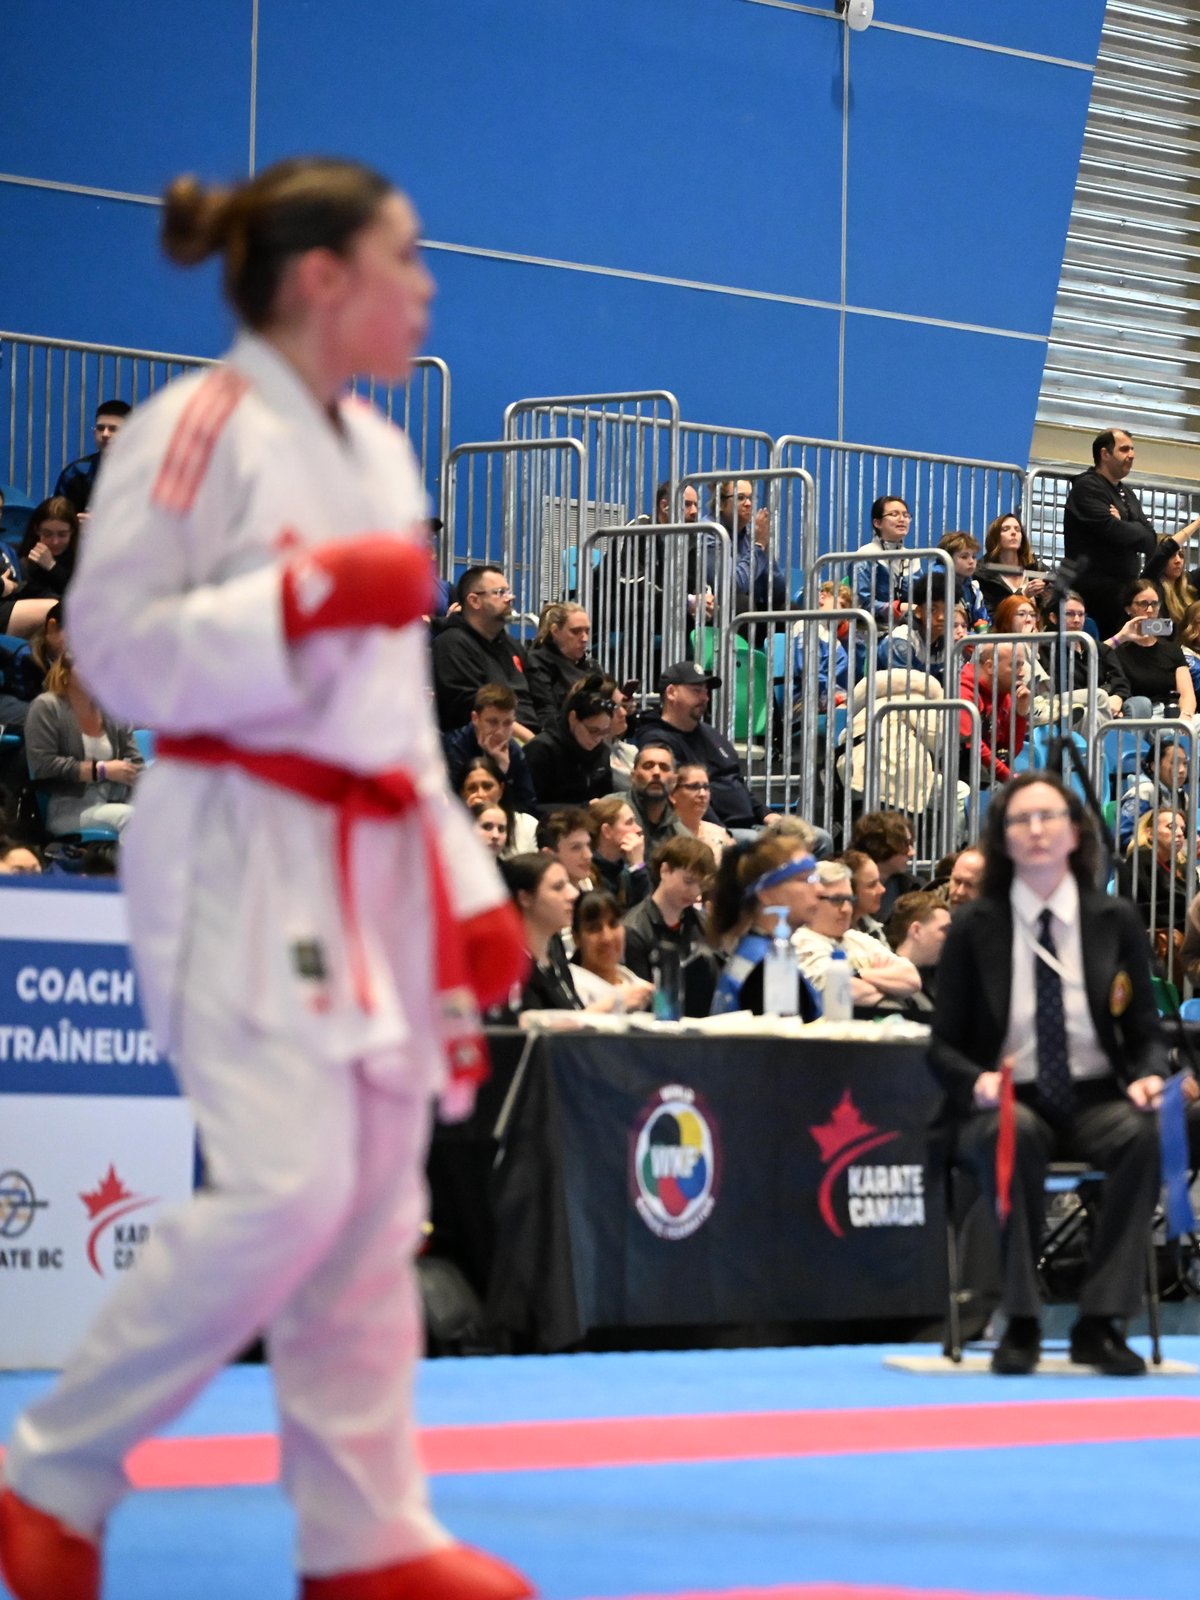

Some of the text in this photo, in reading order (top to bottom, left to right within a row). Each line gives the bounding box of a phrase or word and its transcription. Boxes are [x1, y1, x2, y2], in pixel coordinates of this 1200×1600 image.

[16, 966, 134, 1005] COACH
[847, 1164, 925, 1195] KARATE
[848, 1195, 927, 1227] CANADA
